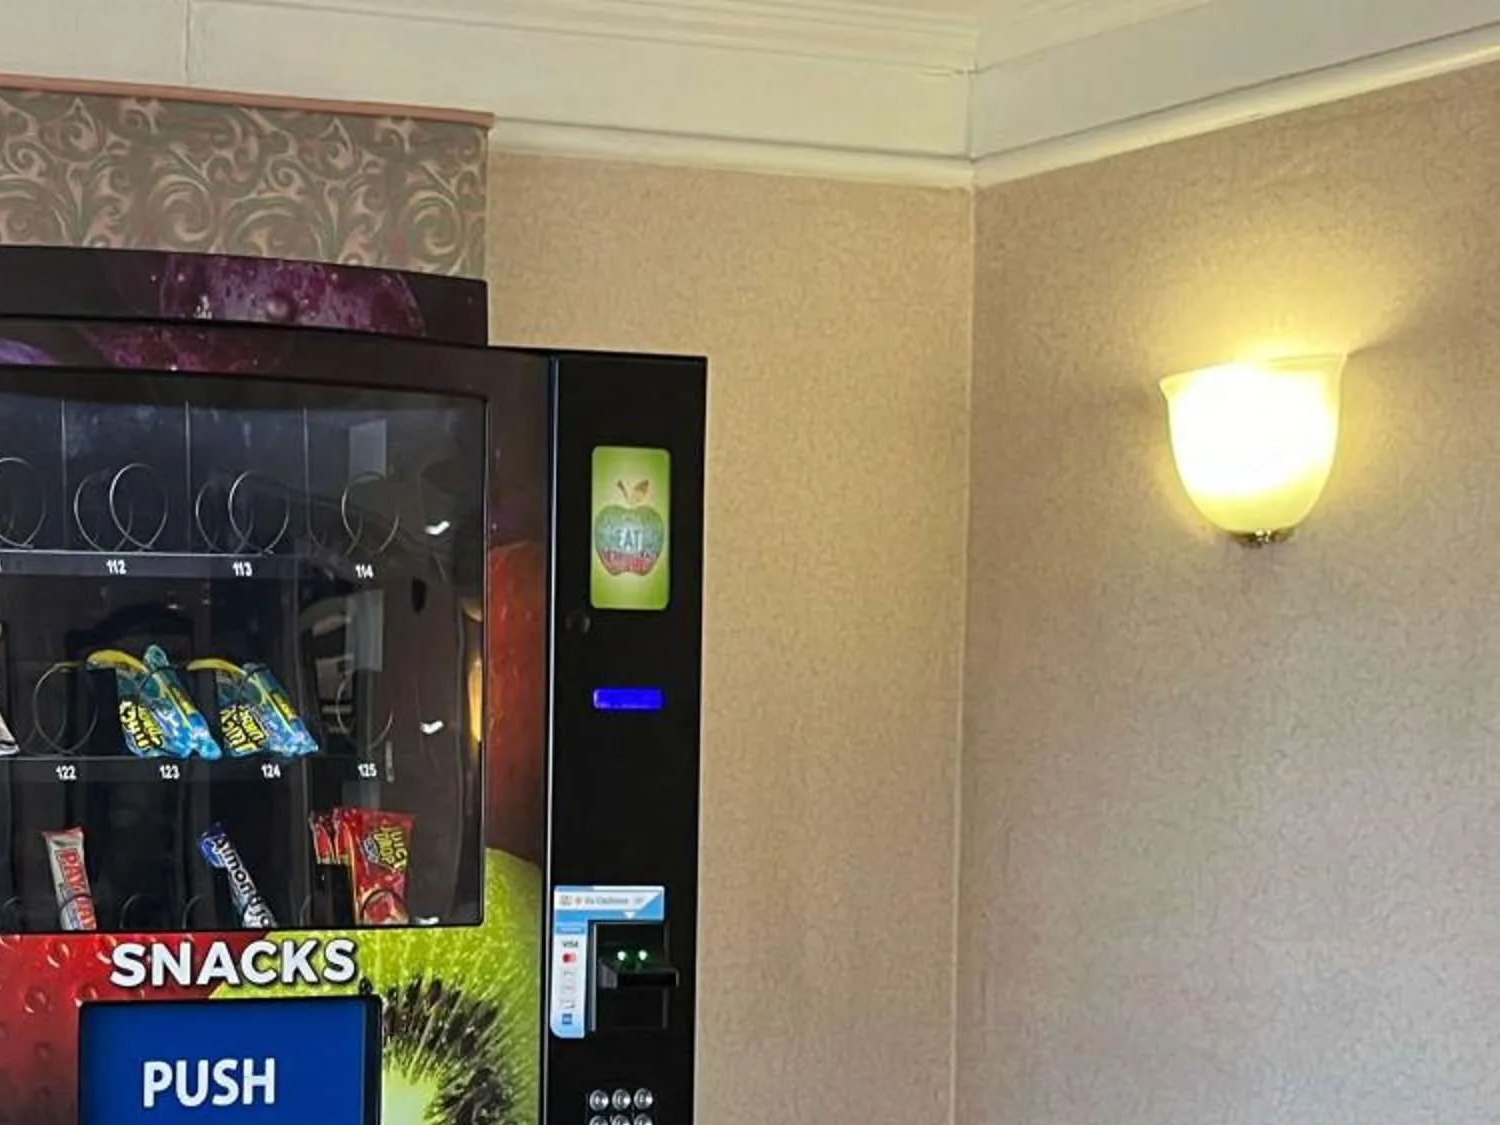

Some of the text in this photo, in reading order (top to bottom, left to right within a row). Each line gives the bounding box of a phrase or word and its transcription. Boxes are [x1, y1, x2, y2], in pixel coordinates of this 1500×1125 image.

[106, 559, 127, 574] 112
[232, 561, 252, 577] 113
[355, 565, 374, 578] 114
[56, 765, 77, 780] 122
[160, 765, 181, 779] 123
[262, 763, 281, 778] 124
[358, 763, 377, 777] 125
[110, 939, 357, 988] SNACKS
[143, 1058, 276, 1108] PUSH
